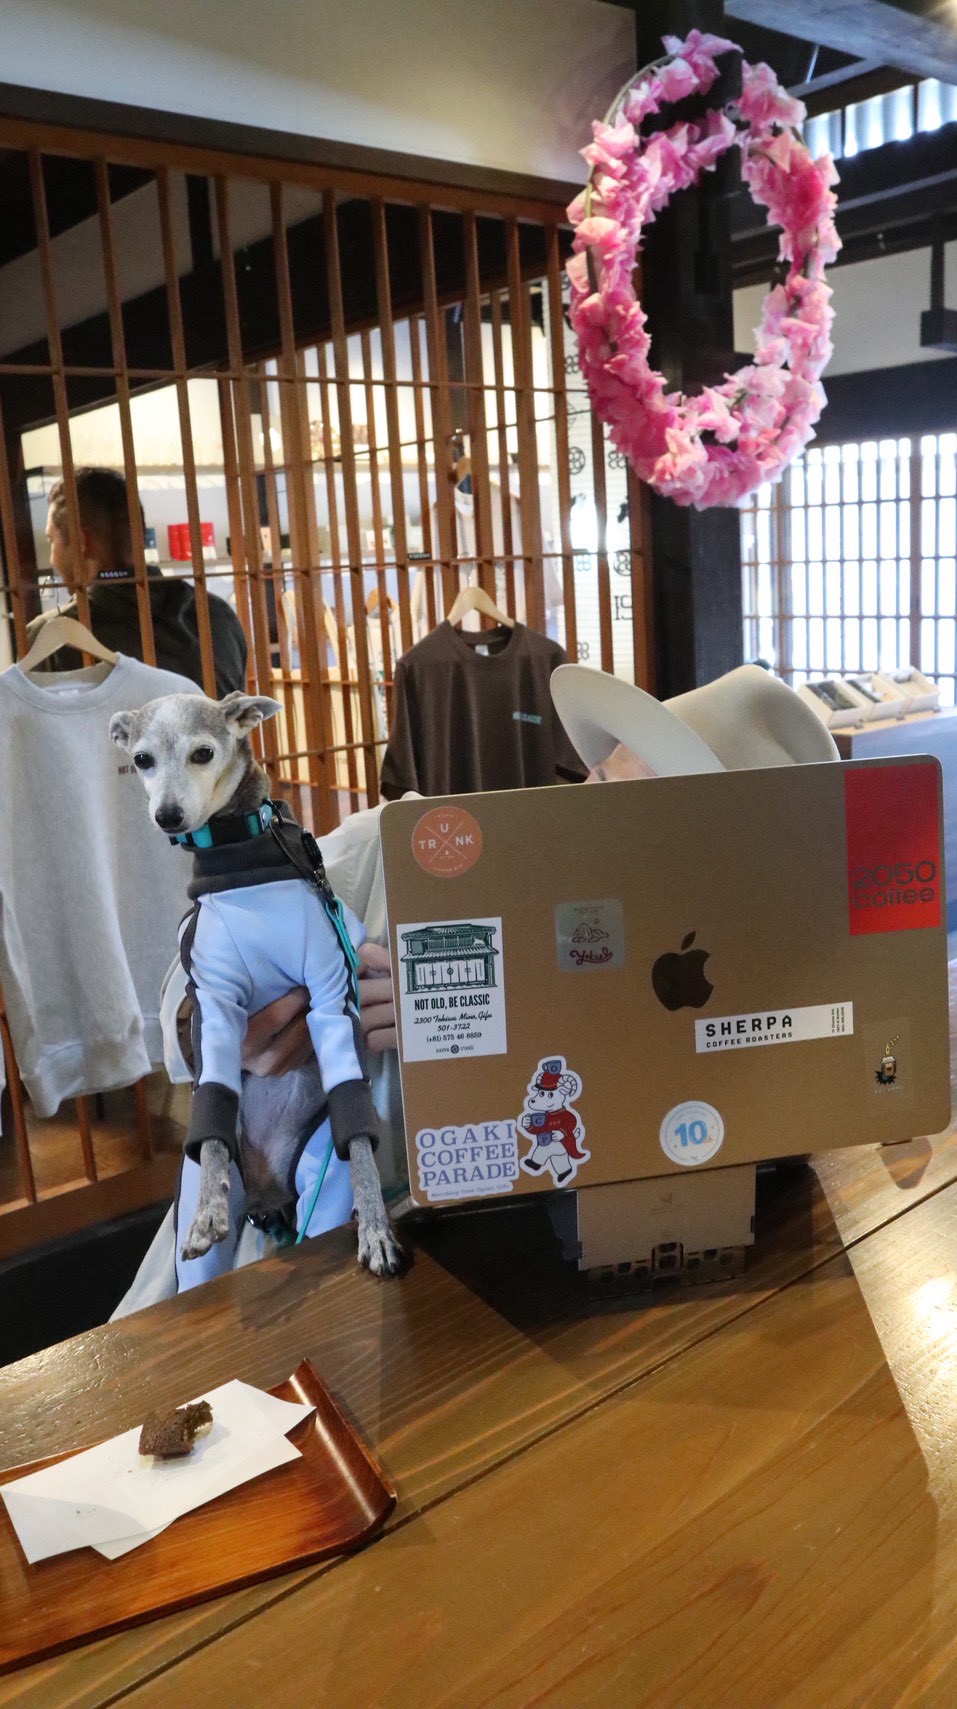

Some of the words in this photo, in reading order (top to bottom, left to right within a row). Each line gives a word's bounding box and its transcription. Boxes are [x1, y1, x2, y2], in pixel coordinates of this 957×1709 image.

[852, 861, 936, 890] 2050
[414, 998, 430, 1011] NOT
[431, 997, 447, 1010] OLD,
[449, 996, 458, 1008] BE
[460, 993, 490, 1007] CLASSIC
[437, 1023, 471, 1032] 501-3722
[705, 1015, 792, 1037] SHERPA
[426, 1035, 442, 1043] (+81)
[706, 1038, 742, 1048] COFFEE
[745, 1032, 793, 1043] ROASTERS
[419, 1123, 514, 1149] OGAKI
[674, 1119, 707, 1147] 10
[421, 1142, 515, 1168] COFFEE
[422, 1161, 516, 1187] PARADE
